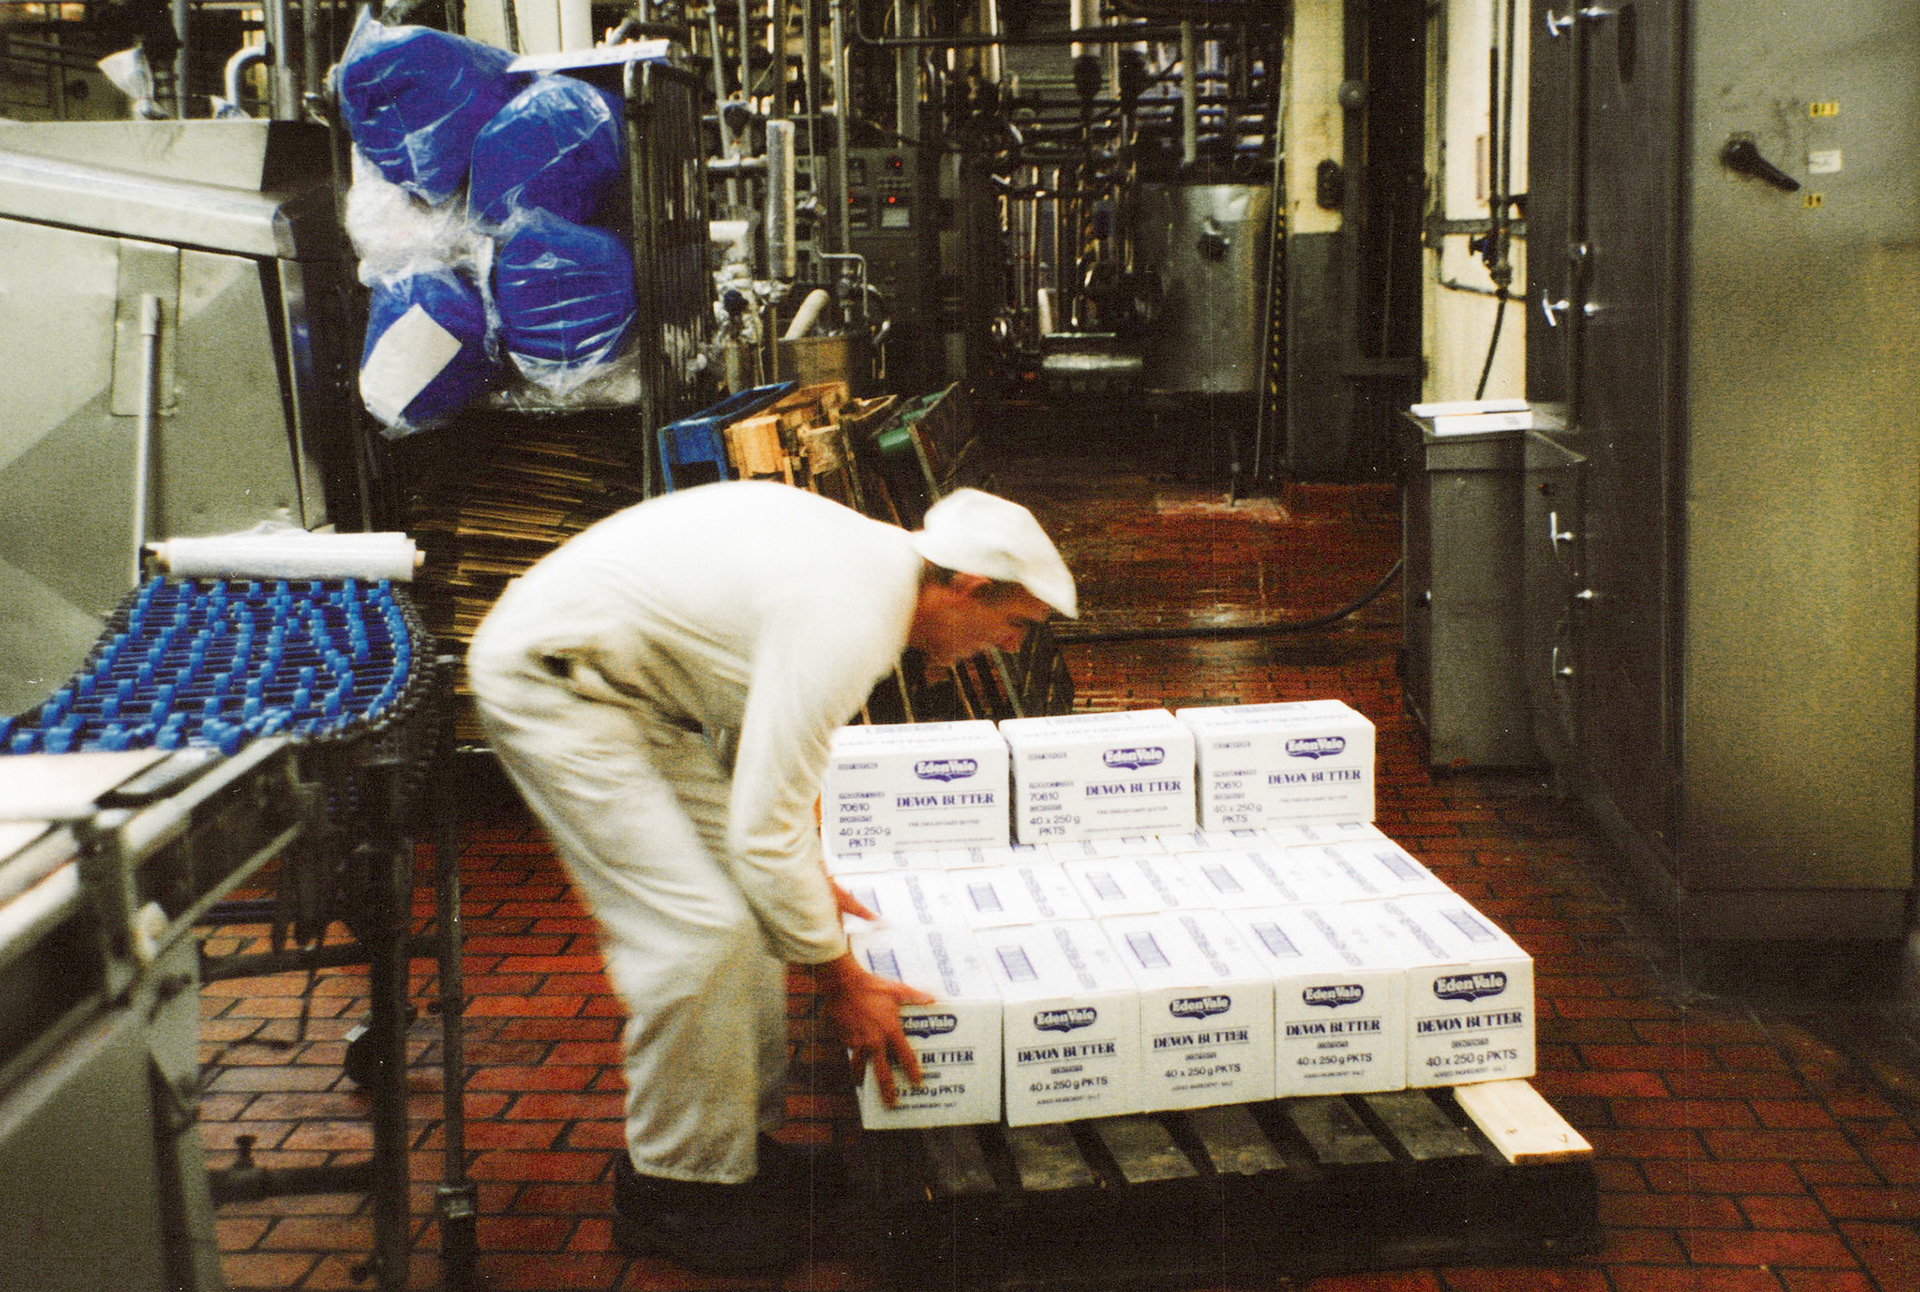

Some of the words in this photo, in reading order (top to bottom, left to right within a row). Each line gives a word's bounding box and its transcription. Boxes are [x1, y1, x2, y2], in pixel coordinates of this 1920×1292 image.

[1268, 773, 1307, 785] DEVON
[1311, 770, 1361, 782] BUTTER
[1086, 784, 1126, 796] DEVON
[1130, 781, 1181, 793] BUTTER
[896, 795, 938, 808] DEVON
[942, 793, 994, 806] BUTTER
[1213, 804, 1226, 813] 40
[1030, 816, 1044, 825] 40
[1222, 814, 1248, 824] PKTS
[839, 828, 854, 836] 40
[1038, 826, 1066, 836] PKTS
[849, 838, 876, 848] PKTS
[1286, 1023, 1326, 1036] DEVON
[1330, 1020, 1380, 1033] BUTTER
[1417, 1018, 1462, 1033] DEVON
[1466, 1012, 1522, 1028] BUTTER
[1154, 1034, 1194, 1048] DEVON
[1198, 1030, 1248, 1044] BUTTER
[1018, 1048, 1058, 1062] DEVON
[1063, 1042, 1115, 1058] BUTTER
[1296, 1057, 1309, 1066] 40
[1319, 1055, 1338, 1064] 250
[1346, 1053, 1372, 1062] PKTS
[1426, 1056, 1441, 1067] 40
[1453, 1053, 1474, 1064] 250
[1486, 1049, 1518, 1061] PKTS
[1164, 1069, 1178, 1078] 40
[1188, 1066, 1206, 1076] 250
[1215, 1063, 1241, 1073] PKTS
[910, 1086, 929, 1097] 250
[940, 1084, 966, 1095] PKTS
[1029, 1082, 1043, 1092] 40
[1053, 1080, 1072, 1090] 250
[1082, 1076, 1108, 1087] PKTS
